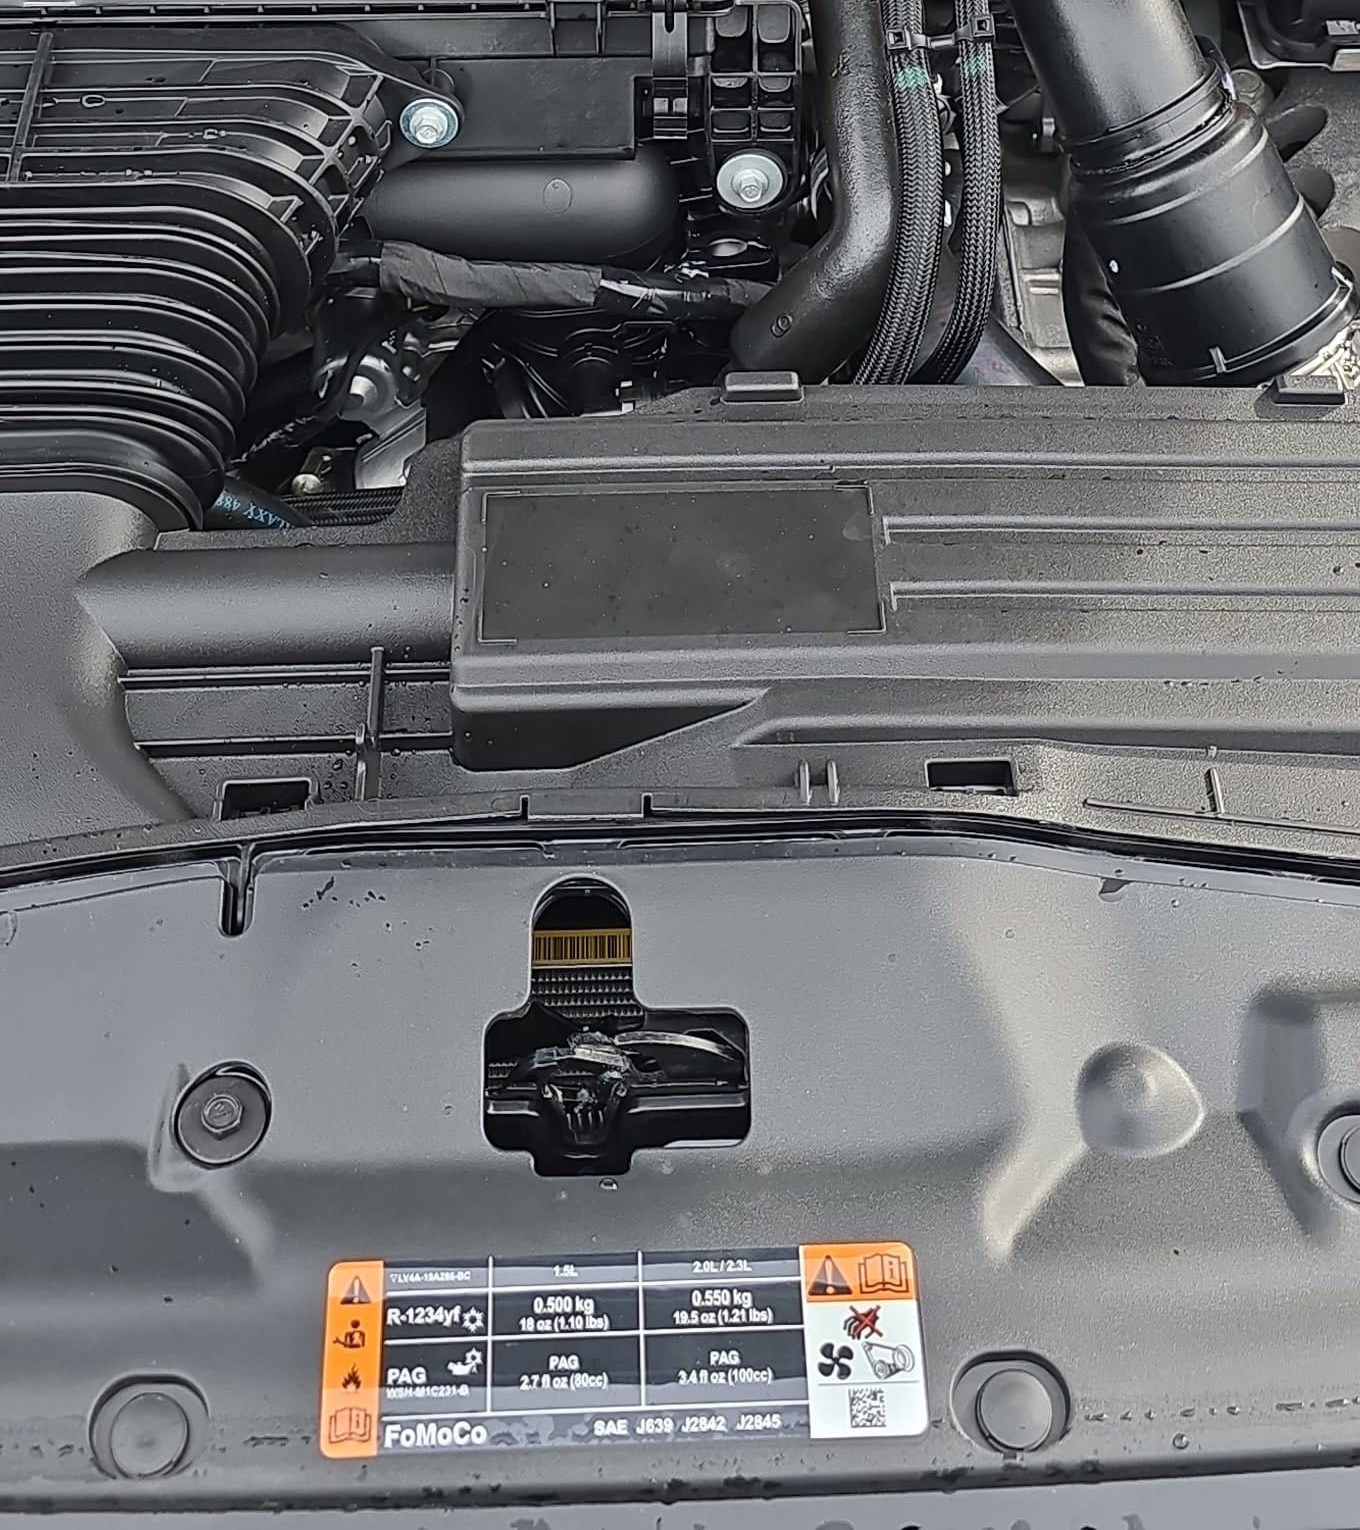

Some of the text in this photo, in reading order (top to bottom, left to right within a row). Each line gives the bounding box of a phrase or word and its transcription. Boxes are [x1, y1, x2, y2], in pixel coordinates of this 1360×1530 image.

[552, 1264, 579, 1278] 1.5L
[692, 1260, 718, 1274] 2.0L
[726, 1259, 752, 1272] 2.3L
[533, 1296, 595, 1316] 0.500 kg
[691, 1289, 753, 1308] 0.550 kg
[386, 1306, 462, 1327] R-1234yf
[519, 1314, 610, 1332] 18 oz (1.10 lbs)
[673, 1307, 773, 1325] 19.5 oz (1.21 lbs)
[548, 1355, 580, 1371] PAG
[709, 1349, 741, 1366] PAG
[386, 1367, 428, 1385] PAG
[519, 1372, 610, 1390] 2.7 fl oz (80cc)
[677, 1366, 773, 1385] 3.4 fl oz (100cc)
[593, 1413, 783, 1437] SAE J639 J2842 J2845
[383, 1420, 488, 1449] FoMoCo
